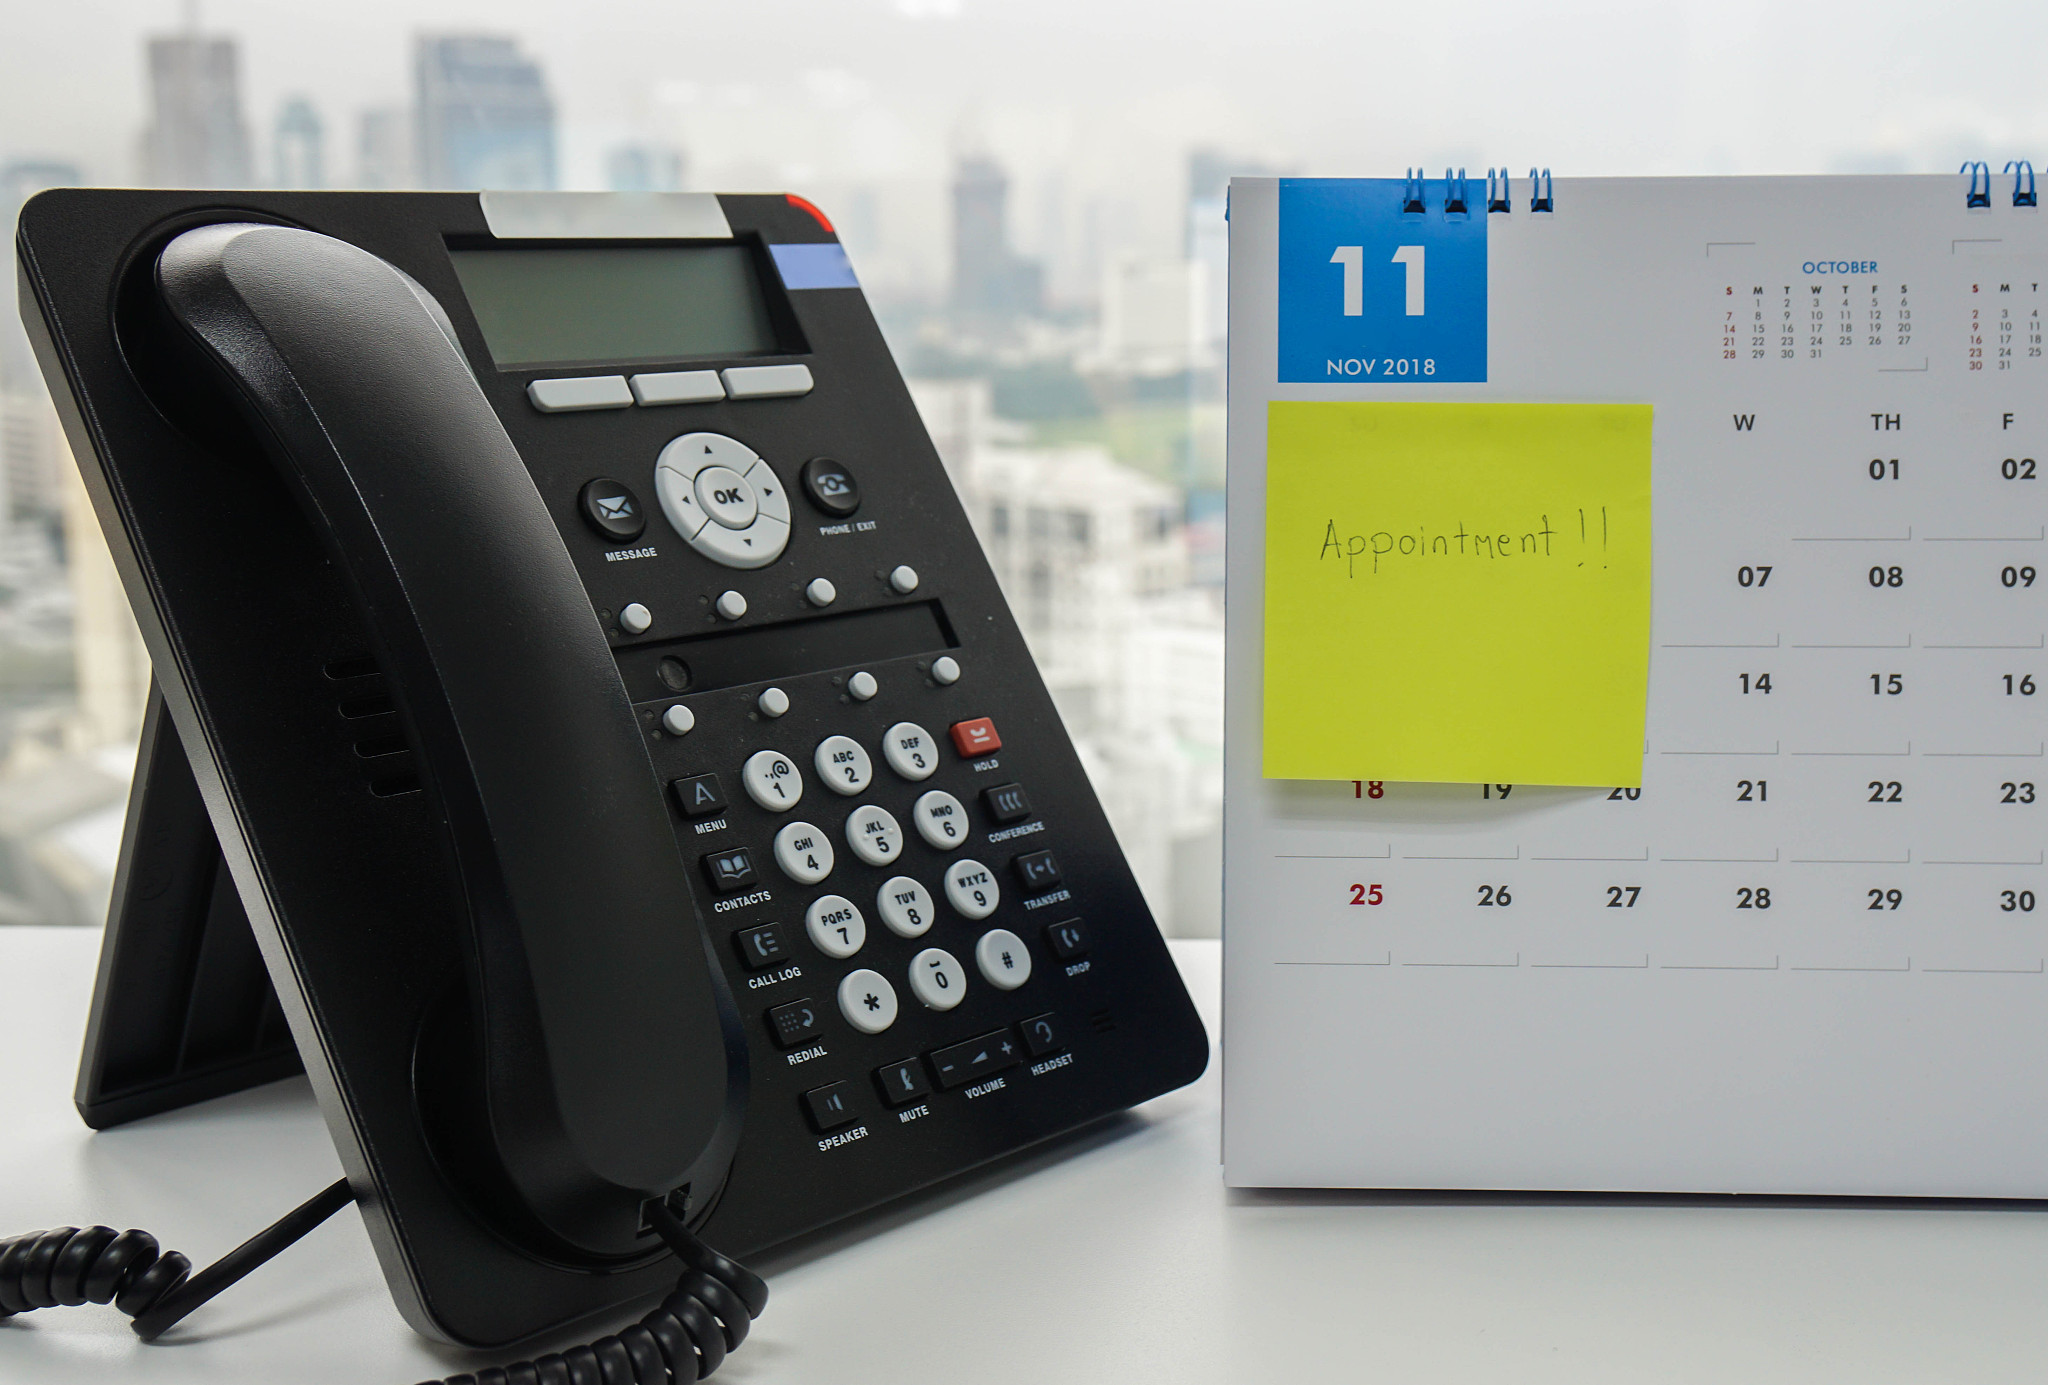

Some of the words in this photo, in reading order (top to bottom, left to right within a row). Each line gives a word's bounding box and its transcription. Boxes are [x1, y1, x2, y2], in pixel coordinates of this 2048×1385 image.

[1803, 261, 1877, 274] OCTOBER
[1330, 246, 1425, 316] 11
[1972, 284, 1979, 293] S
[1999, 283, 2010, 293] M
[2031, 282, 2038, 292] T
[1726, 286, 1733, 296] S
[1753, 286, 1764, 295] M
[1783, 285, 1791, 295] T
[1810, 285, 1822, 295] W
[1842, 285, 1849, 294] T
[1871, 285, 1878, 294] F
[1900, 284, 1908, 294] S
[1783, 298, 1791, 307] 2
[1812, 298, 1820, 307] 3
[1842, 298, 1849, 307] 4
[1871, 298, 1879, 307] 5
[1900, 297, 1908, 306] 6
[1726, 311, 1733, 321] 7
[1754, 311, 1762, 320] 8
[1783, 311, 1791, 320] 9
[1811, 311, 1824, 320] 10
[1840, 310, 1851, 320] 11
[1869, 310, 1882, 320] 12
[1898, 310, 1911, 319] 13
[1972, 309, 1979, 319] 2
[2001, 309, 2009, 318] 3
[2031, 309, 2038, 318] 4
[1724, 324, 1736, 334] 14
[1753, 324, 1765, 333] 15
[1782, 324, 1794, 333] 16
[1811, 323, 1824, 332] 17
[1840, 323, 1853, 332] 18
[1869, 323, 1882, 332] 19
[1897, 323, 1912, 332] 20
[1971, 322, 1980, 331] 9
[1999, 322, 2013, 331] 10
[2029, 321, 2041, 331] 11
[1722, 337, 1735, 346] 21
[1751, 337, 1765, 346] 22
[1780, 337, 1794, 346] 23
[1810, 336, 1823, 345] 24
[1839, 336, 1853, 345] 25
[1868, 336, 1882, 345] 26
[1897, 335, 1911, 345] 27
[1970, 335, 1983, 344] 16
[1999, 334, 2012, 344] 17
[2029, 334, 2042, 344] 18
[1722, 350, 1737, 359] 28
[1751, 349, 1765, 358] 29
[1780, 349, 1795, 358] 30
[1809, 349, 1822, 358] 31
[1968, 348, 1983, 357] 23
[1998, 348, 2012, 357] 24
[2028, 347, 2042, 357] 25
[1328, 359, 1376, 375] NOV
[1384, 359, 1435, 375] 2018
[1969, 361, 1983, 370] 30
[1998, 360, 2011, 370] 31
[1733, 414, 1755, 431] W
[1871, 414, 1900, 430] TH
[2003, 413, 2013, 429] F
[1869, 459, 1898, 480] 01
[2002, 458, 2036, 480] 02
[714, 488, 744, 504] OK
[820, 524, 850, 535] PHONE
[856, 521, 876, 531] EXIT
[605, 547, 657, 561] MESSAGE
[1320, 515, 1556, 578] Appointment
[1738, 566, 1772, 587] 07
[1869, 566, 1903, 587] 08
[2001, 566, 2036, 587] 09
[1739, 673, 1772, 694] 14
[1871, 674, 1902, 695] 15
[2003, 674, 2035, 695] 16
[901, 737, 919, 749] DEF
[833, 751, 854, 763] ABC
[912, 753, 925, 768] 3
[974, 759, 998, 771] HOLD
[845, 767, 859, 783] 2
[774, 782, 786, 798] 1
[1351, 781, 1385, 799] 18
[1483, 784, 1513, 800] 19
[1737, 780, 1766, 801] 21
[1868, 781, 1902, 802] 22
[2001, 782, 2035, 804] 23
[930, 805, 952, 817] MNO
[695, 819, 726, 834] MENU
[866, 821, 884, 833] JKL
[943, 821, 956, 837] 6
[989, 821, 1045, 843] CONFERENCE
[794, 837, 813, 851] GHI
[876, 836, 889, 852] 5
[808, 855, 819, 870] 4
[958, 872, 988, 888] WXYZ
[715, 891, 771, 912] CONTACTS
[895, 891, 915, 904] TUV
[974, 891, 986, 906] 9
[1024, 890, 1070, 910] TRANSFER
[1350, 884, 1383, 905] 25
[1478, 885, 1511, 906] 26
[1607, 886, 1641, 907] 27
[1737, 888, 1771, 909] 28
[1868, 889, 1902, 910] 29
[2001, 890, 2035, 912] 30
[821, 909, 852, 926] PQRS
[907, 908, 921, 925] 8
[837, 927, 849, 944] 7
[1002, 952, 1013, 969] #
[1066, 961, 1090, 976] DROP
[748, 976, 777, 989] CALL
[778, 967, 802, 981] LOG
[935, 971, 948, 989] 0
[787, 1046, 827, 1065] REDIAL
[1031, 1054, 1072, 1075] HEADSET
[965, 1078, 1006, 1098] VOLUME
[899, 1105, 929, 1122] MUTE
[818, 1127, 868, 1151] SPEAKER
